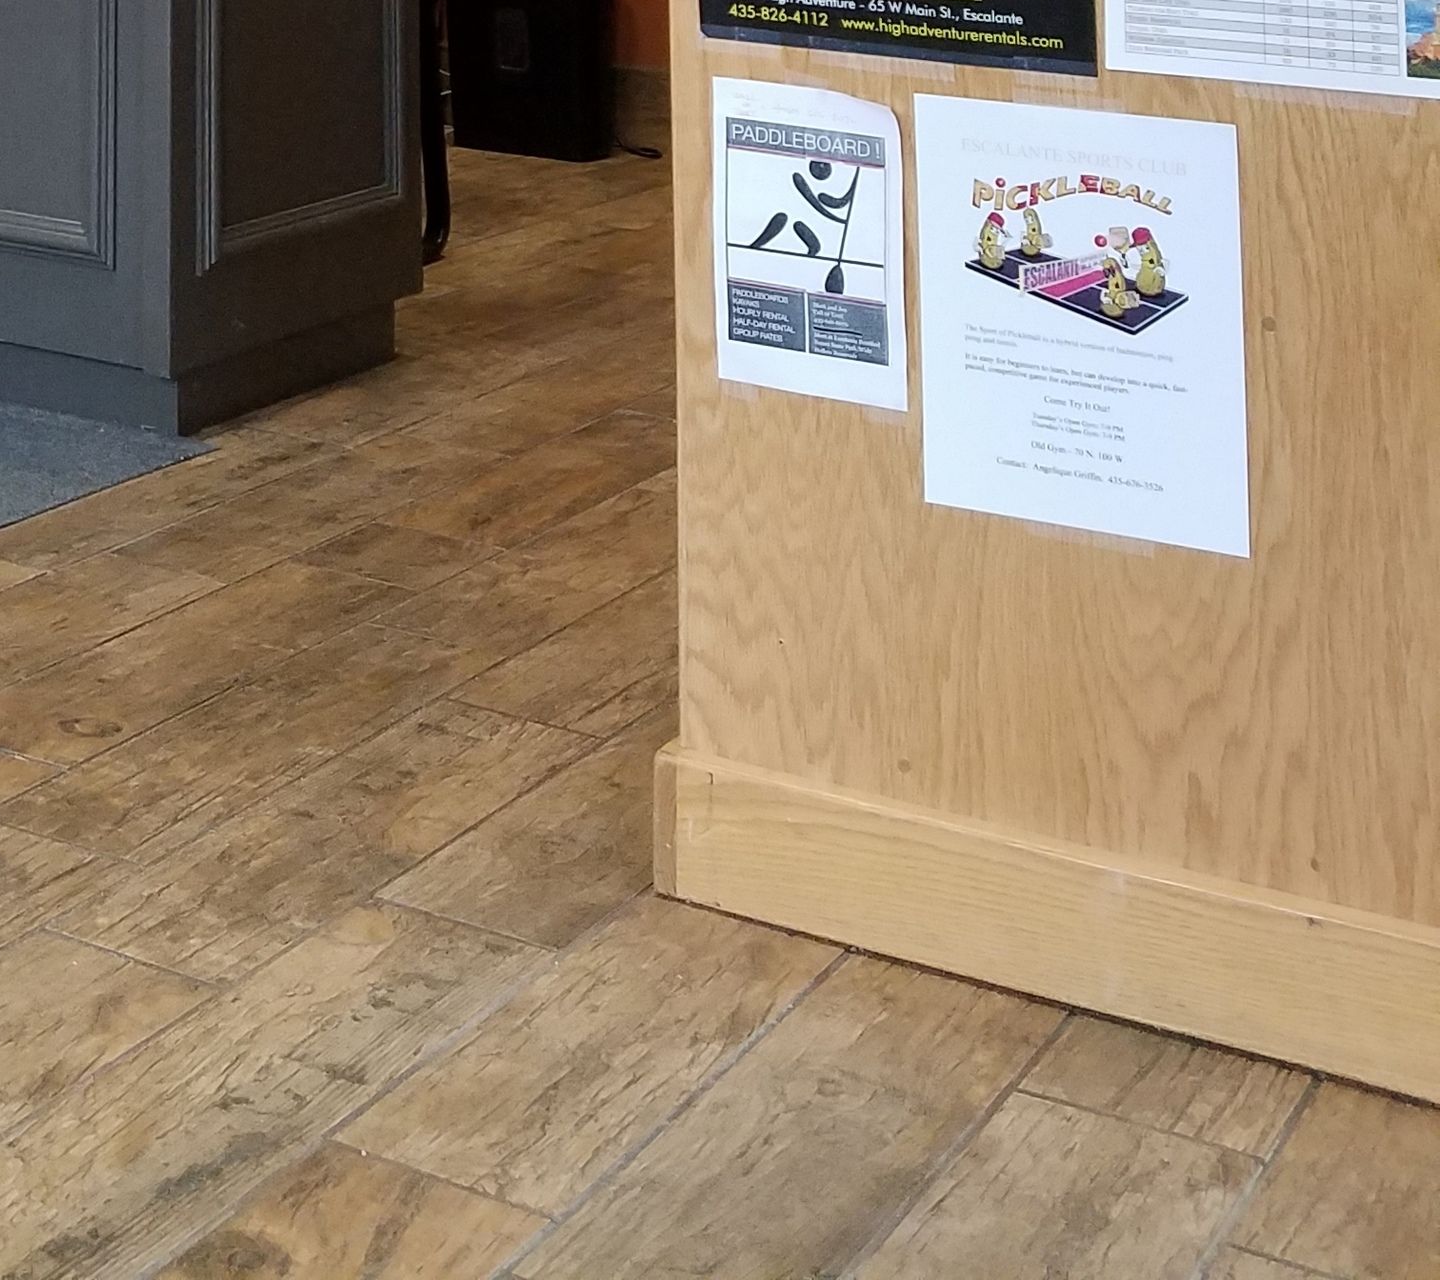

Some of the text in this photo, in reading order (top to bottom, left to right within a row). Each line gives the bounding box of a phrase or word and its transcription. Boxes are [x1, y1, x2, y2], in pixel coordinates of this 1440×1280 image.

[887, 1, 902, 14] W
[905, 2, 936, 18] Main
[963, 8, 1024, 25] Escalante
[728, 2, 1064, 49] 435-826-4112 www.highadventurerentals.com
[731, 123, 871, 158] PADDLEBOARD
[961, 138, 1188, 176] ESCALANTE SPORTS CLUB
[1023, 259, 1079, 289] ESCALANTE
[1043, 395, 1067, 407] Come
[1069, 399, 1082, 410] Try
[1084, 401, 1092, 411] It
[1112, 425, 1124, 433] PM
[1113, 433, 1126, 441] PM
[1030, 440, 1046, 451] Old
[1047, 442, 1067, 455] Gym
[1114, 454, 1124, 464] W
[996, 456, 1027, 469] Contact:
[1032, 463, 1073, 478] Angelique
